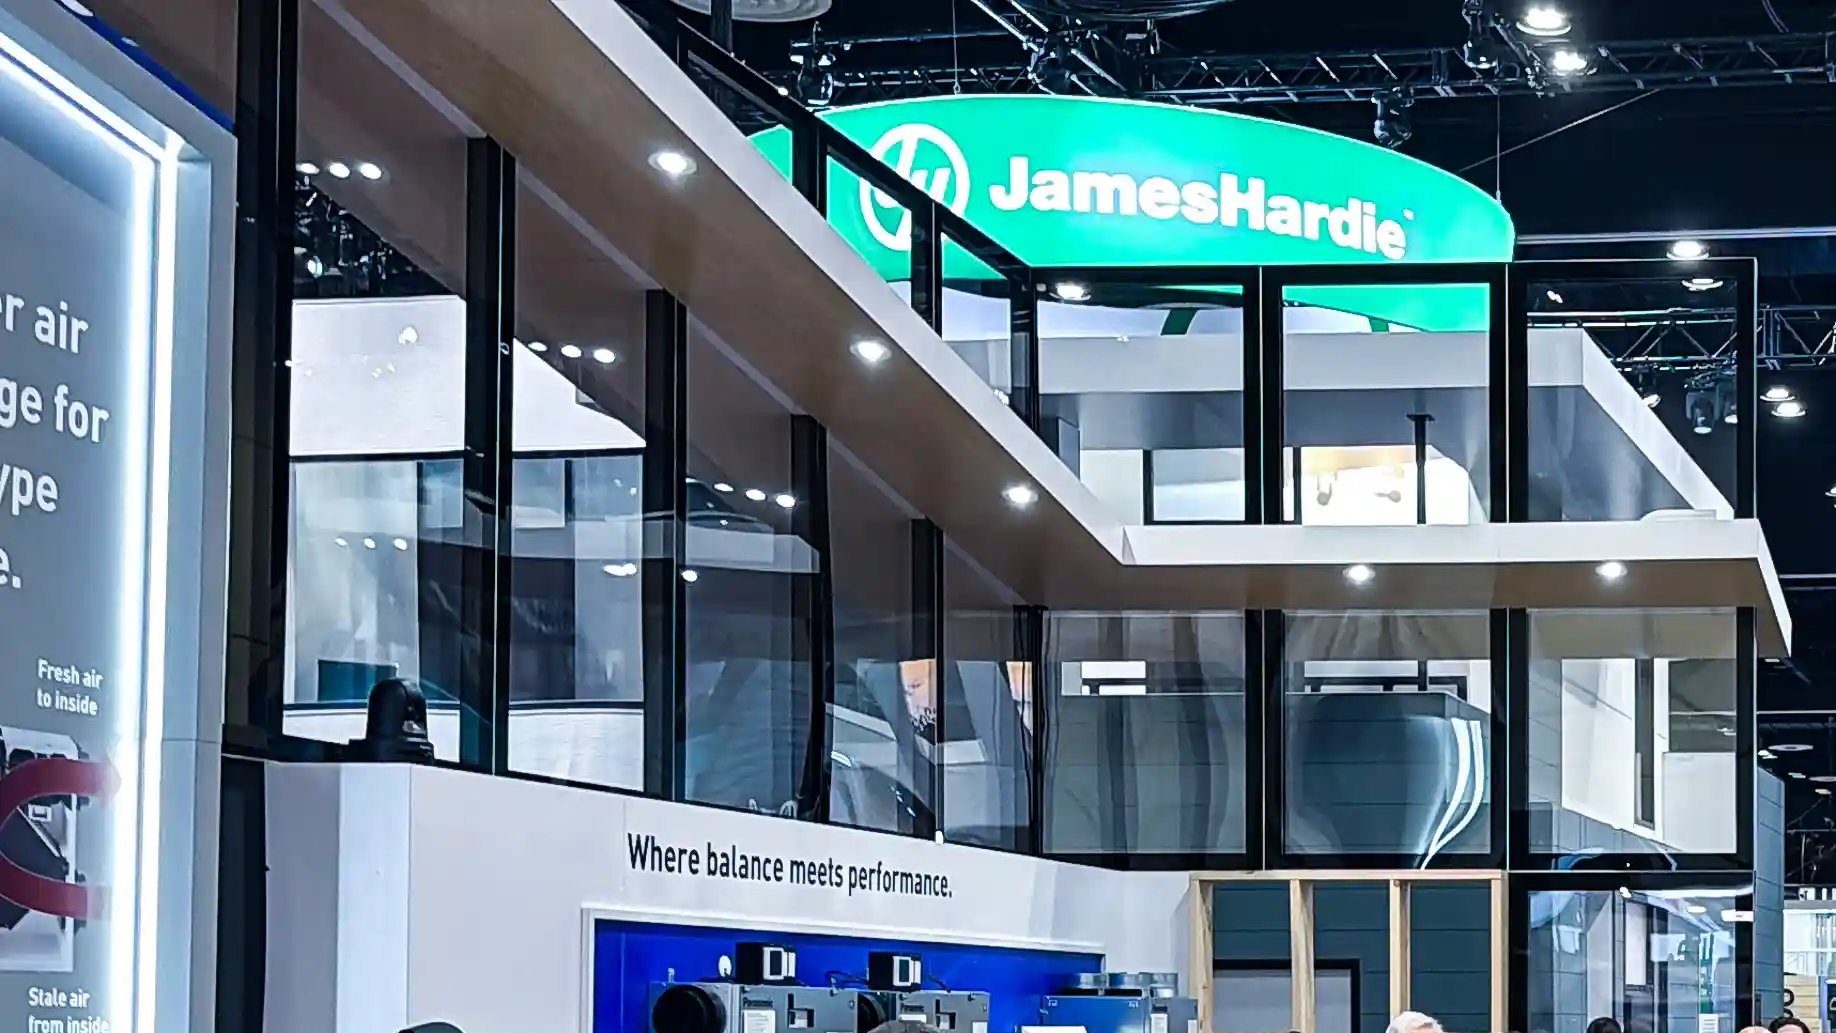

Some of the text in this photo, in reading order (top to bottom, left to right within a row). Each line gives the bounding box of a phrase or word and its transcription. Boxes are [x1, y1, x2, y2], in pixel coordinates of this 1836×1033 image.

[989, 156, 1407, 260] JamesHardie
[0, 293, 89, 354] r air
[54, 384, 110, 443] for
[37, 687, 98, 716] to inside
[38, 658, 104, 689] Fresh air
[627, 832, 953, 898] Where balance meets performance.
[28, 986, 91, 1008] Stale air
